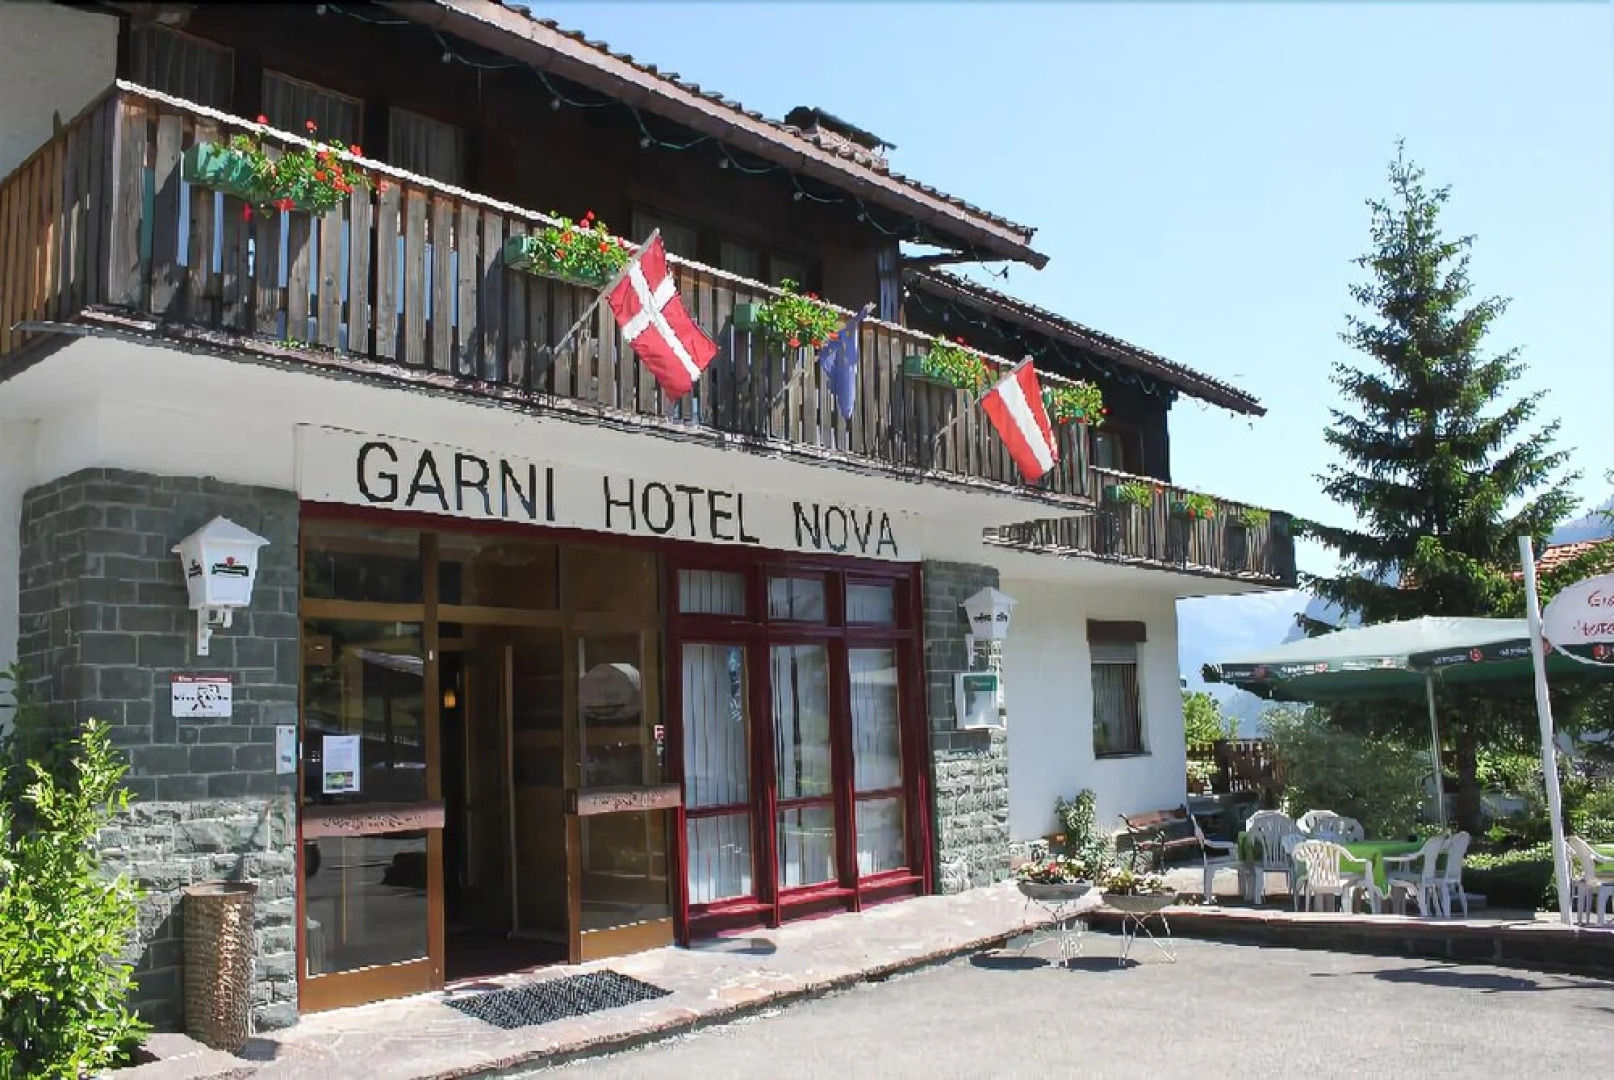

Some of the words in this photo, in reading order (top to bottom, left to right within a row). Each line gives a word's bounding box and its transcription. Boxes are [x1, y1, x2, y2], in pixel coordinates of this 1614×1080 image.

[357, 441, 555, 522] GARNI
[603, 475, 760, 545] HOTEL
[792, 501, 898, 557] NOVA
